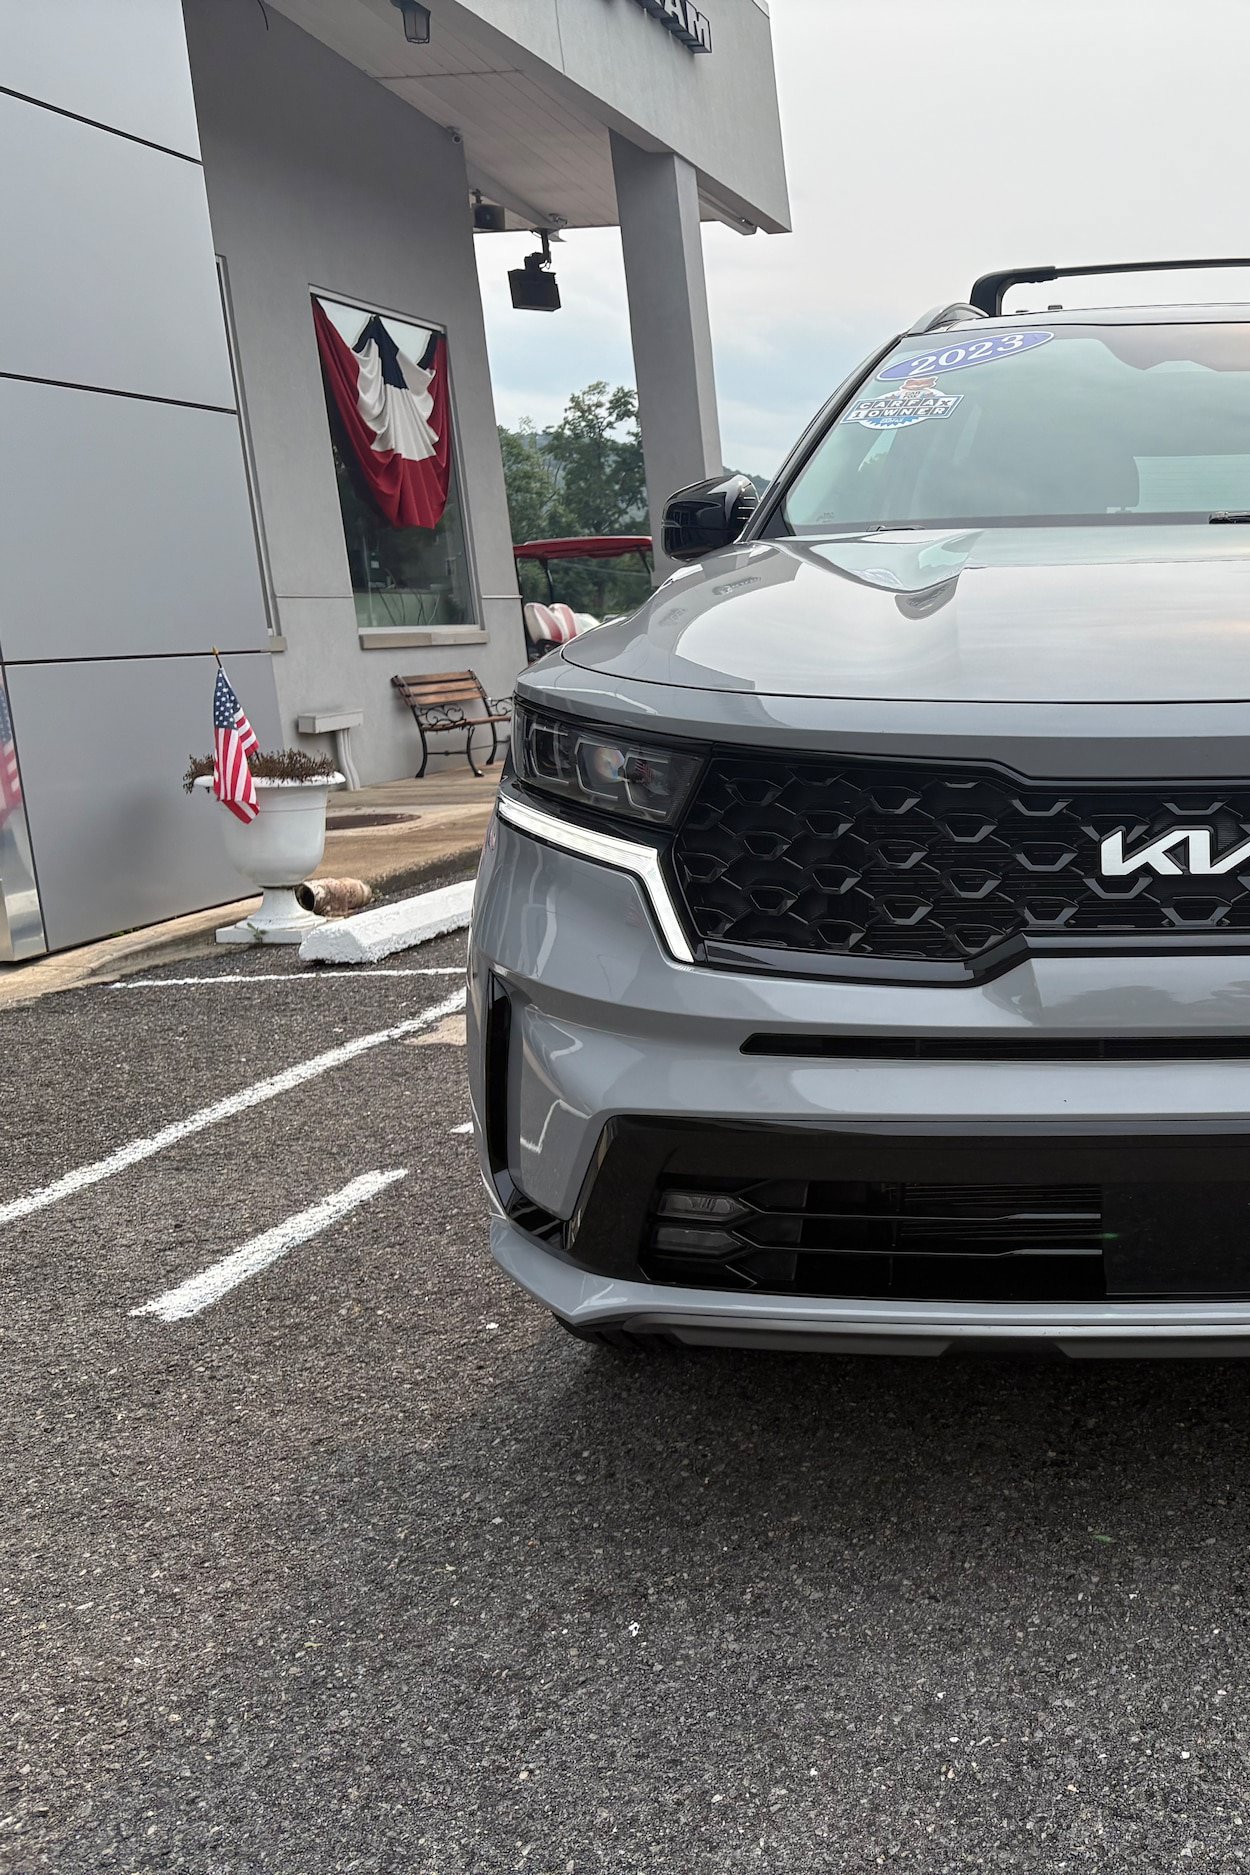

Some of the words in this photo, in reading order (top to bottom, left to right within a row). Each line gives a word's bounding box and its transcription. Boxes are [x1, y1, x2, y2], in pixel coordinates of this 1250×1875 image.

[655, 0, 712, 53] AM
[908, 334, 1025, 375] 2023
[859, 399, 952, 409] CARFAX
[867, 407, 946, 417] OWNER
